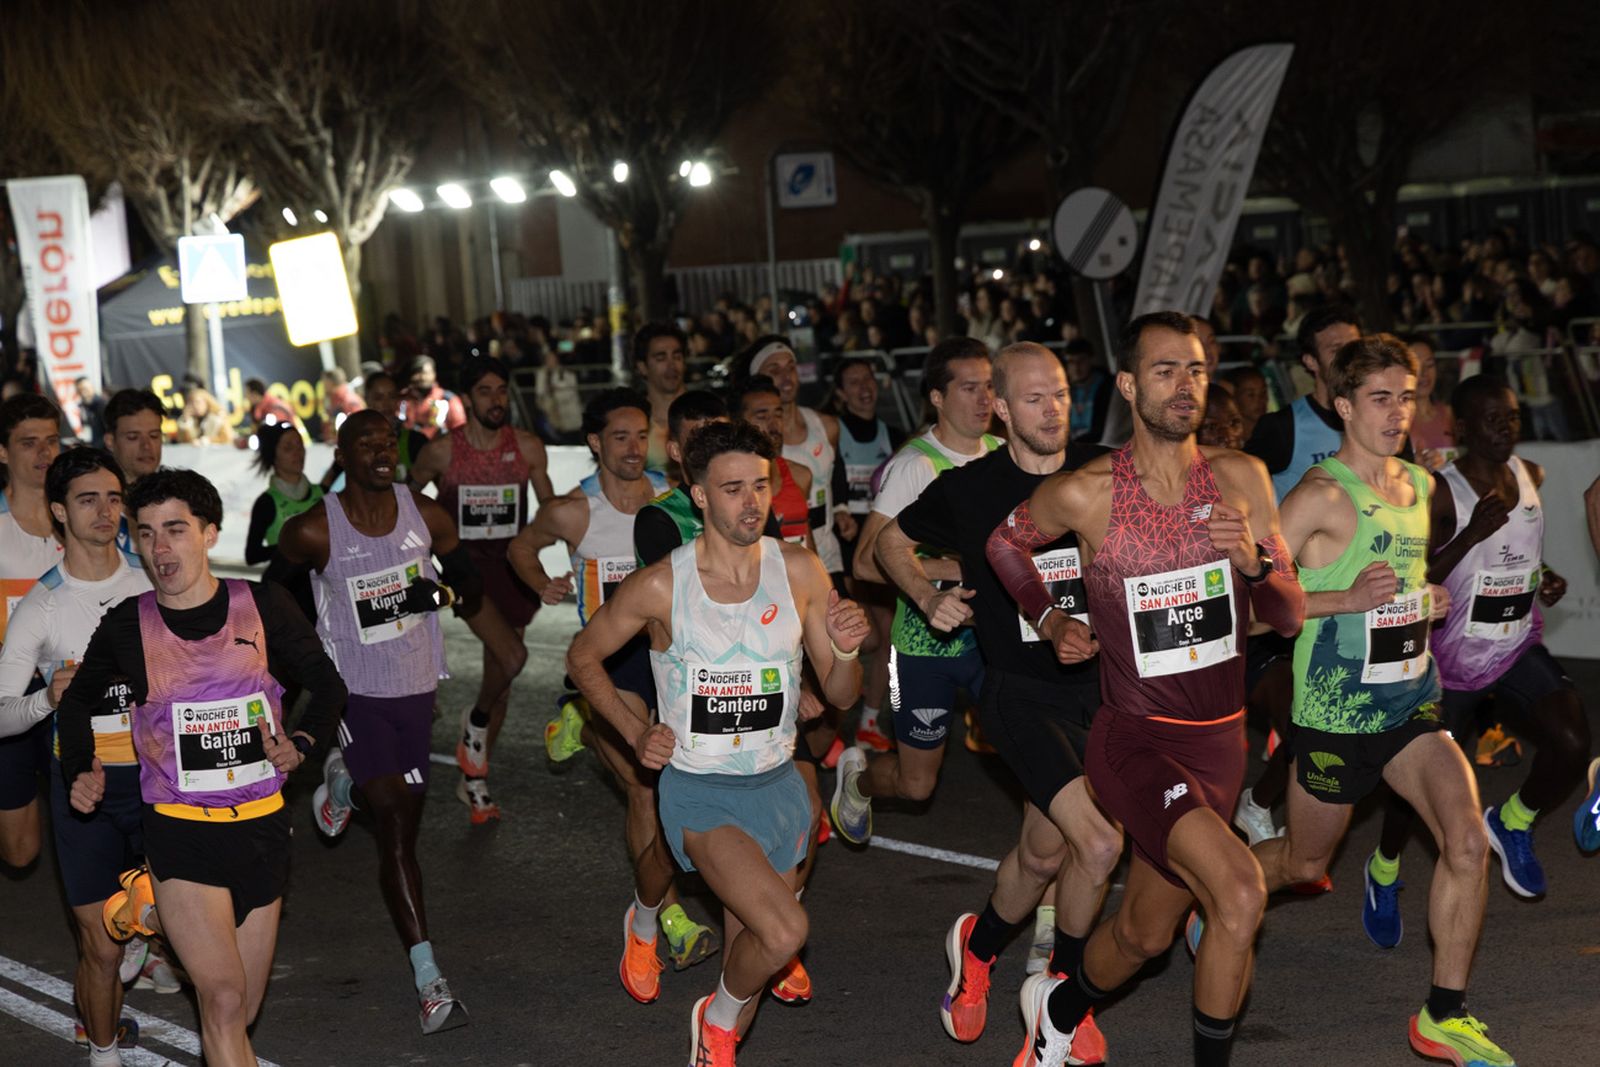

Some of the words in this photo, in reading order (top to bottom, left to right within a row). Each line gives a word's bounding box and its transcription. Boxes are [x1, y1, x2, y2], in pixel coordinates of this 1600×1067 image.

[1066, 558, 1077, 567] DE
[367, 577, 390, 588] NOCHE
[391, 574, 399, 583] DE
[1151, 581, 1183, 596] NOCHE
[1185, 579, 1197, 589] DE
[360, 589, 376, 599] SAN
[1482, 587, 1499, 595] SAN
[1060, 595, 1075, 609] 23
[1140, 597, 1161, 610] SAN
[1164, 590, 1199, 608] ANTÓN
[392, 604, 400, 615] 2
[1410, 602, 1417, 612] DE
[1502, 606, 1515, 617] 22
[1167, 606, 1204, 626] Arce
[1377, 616, 1394, 627] SAN
[1184, 623, 1194, 637] 3
[1403, 640, 1415, 653] 28
[710, 674, 739, 684] NOCHE
[741, 673, 752, 683] DE
[698, 685, 718, 696] SAN
[720, 683, 753, 695] ANTÓN
[119, 695, 127, 707] 5
[707, 697, 768, 714] Cantero
[196, 710, 226, 721] NOCHE
[227, 709, 239, 720] DE
[734, 713, 742, 726] 7
[185, 724, 204, 733] SAN
[207, 719, 240, 732] ANTÓN
[200, 730, 251, 750] Gaitán
[221, 747, 236, 760] 10
[1307, 771, 1340, 786] Unicaja
